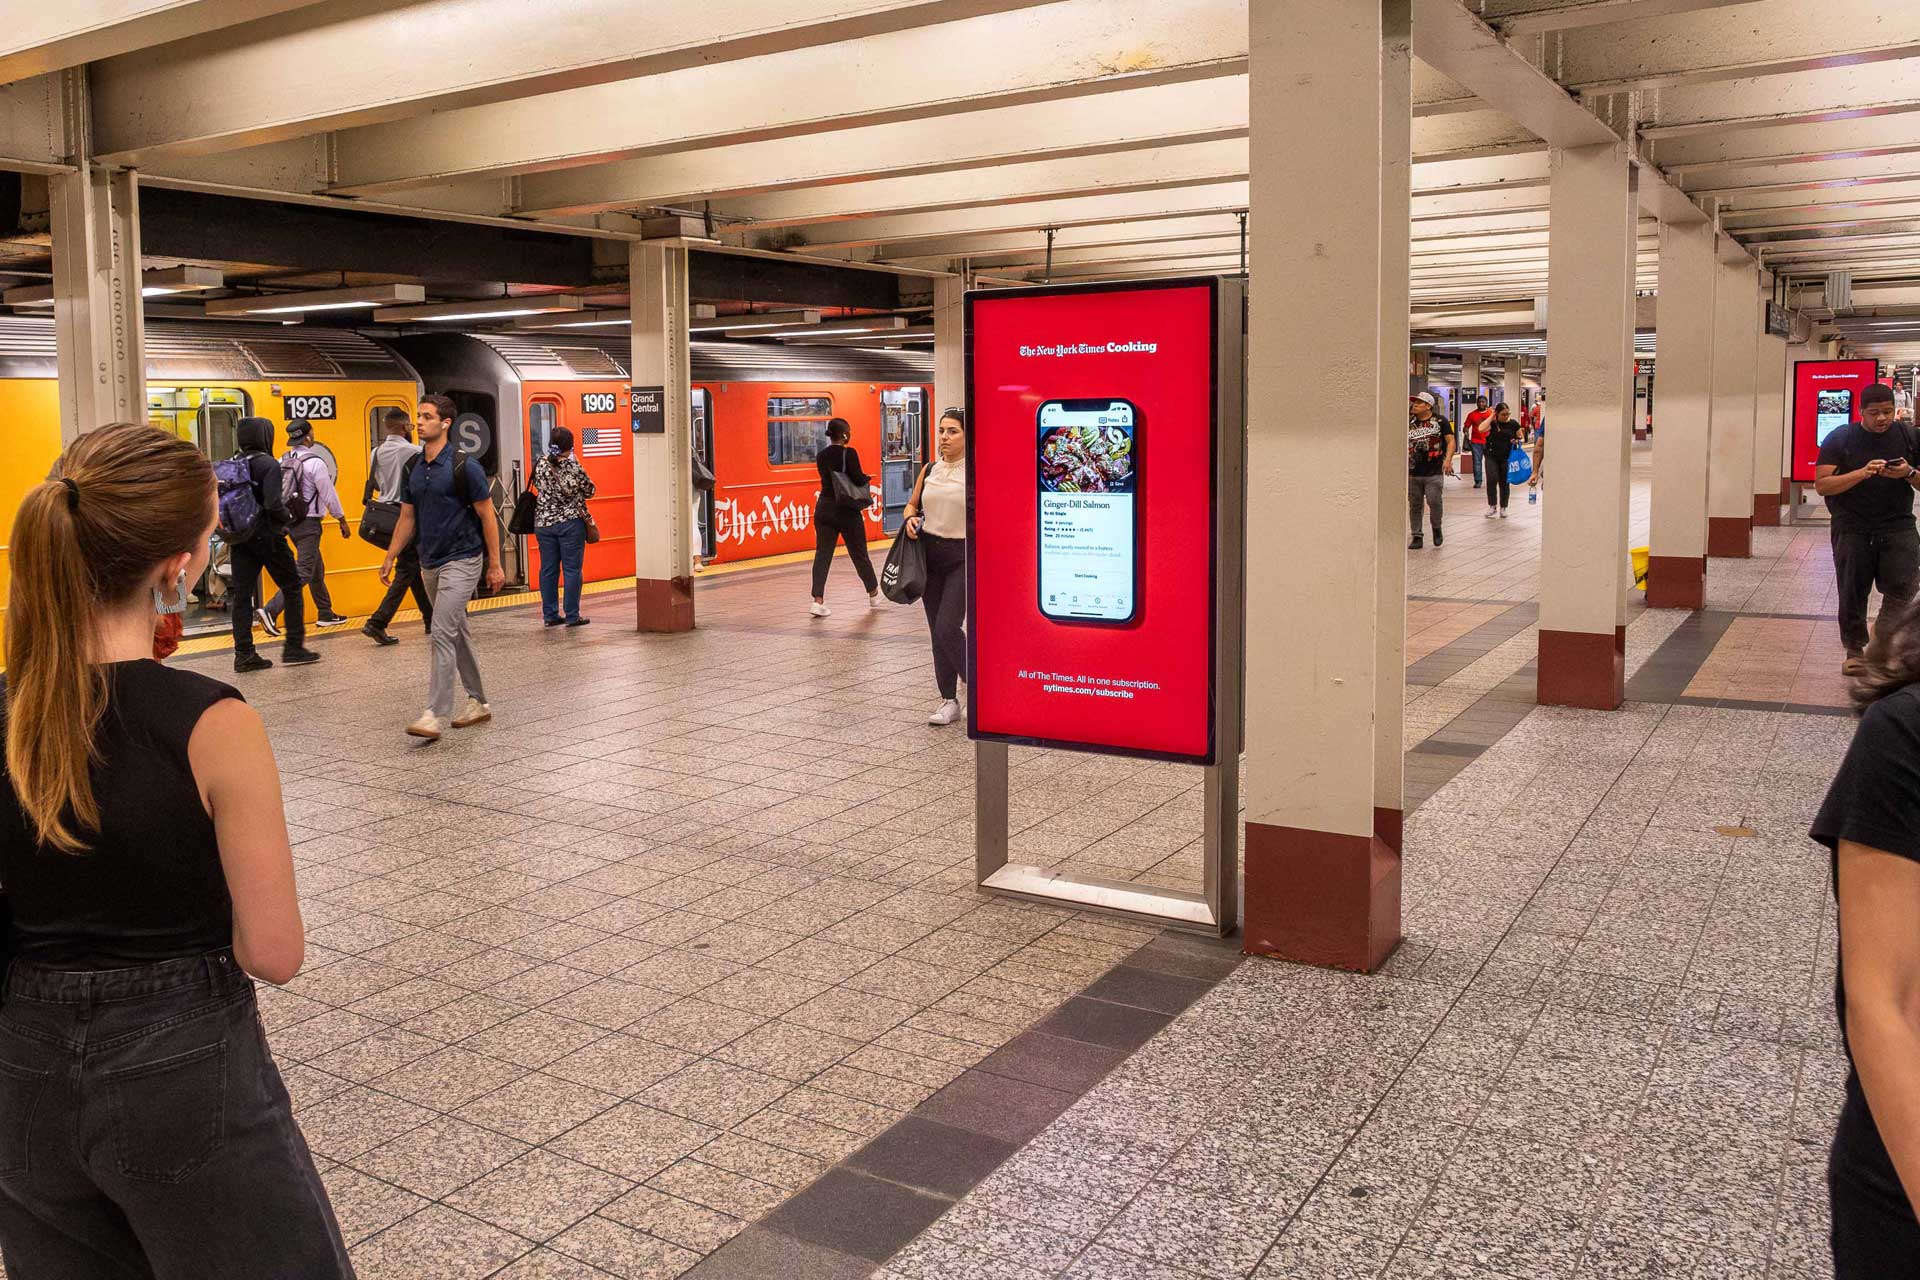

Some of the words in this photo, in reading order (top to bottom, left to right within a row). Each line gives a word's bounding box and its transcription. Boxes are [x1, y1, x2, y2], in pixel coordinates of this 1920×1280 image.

[1019, 345, 1035, 357] The
[1036, 345, 1055, 356] New
[1056, 343, 1078, 357] York
[1078, 343, 1105, 354] Times
[1106, 341, 1157, 354] Cooking
[583, 394, 615, 412] 1906
[631, 394, 654, 403] Grand
[287, 397, 333, 418] 1928
[631, 403, 659, 413] Central
[459, 420, 482, 454] S
[1043, 500, 1081, 510] Ginger-Dill
[1082, 499, 1110, 509] Salmon
[715, 497, 758, 546] The
[761, 493, 810, 541] New
[1018, 670, 1028, 679] All
[1028, 670, 1036, 679] of
[1036, 671, 1051, 681] The
[1051, 672, 1076, 683] Times.
[1076, 674, 1087, 684] All
[1087, 675, 1095, 685] in
[1096, 678, 1110, 686] one
[1112, 679, 1161, 690] subscription.
[1043, 683, 1134, 699] nytimes.com/subscribe
